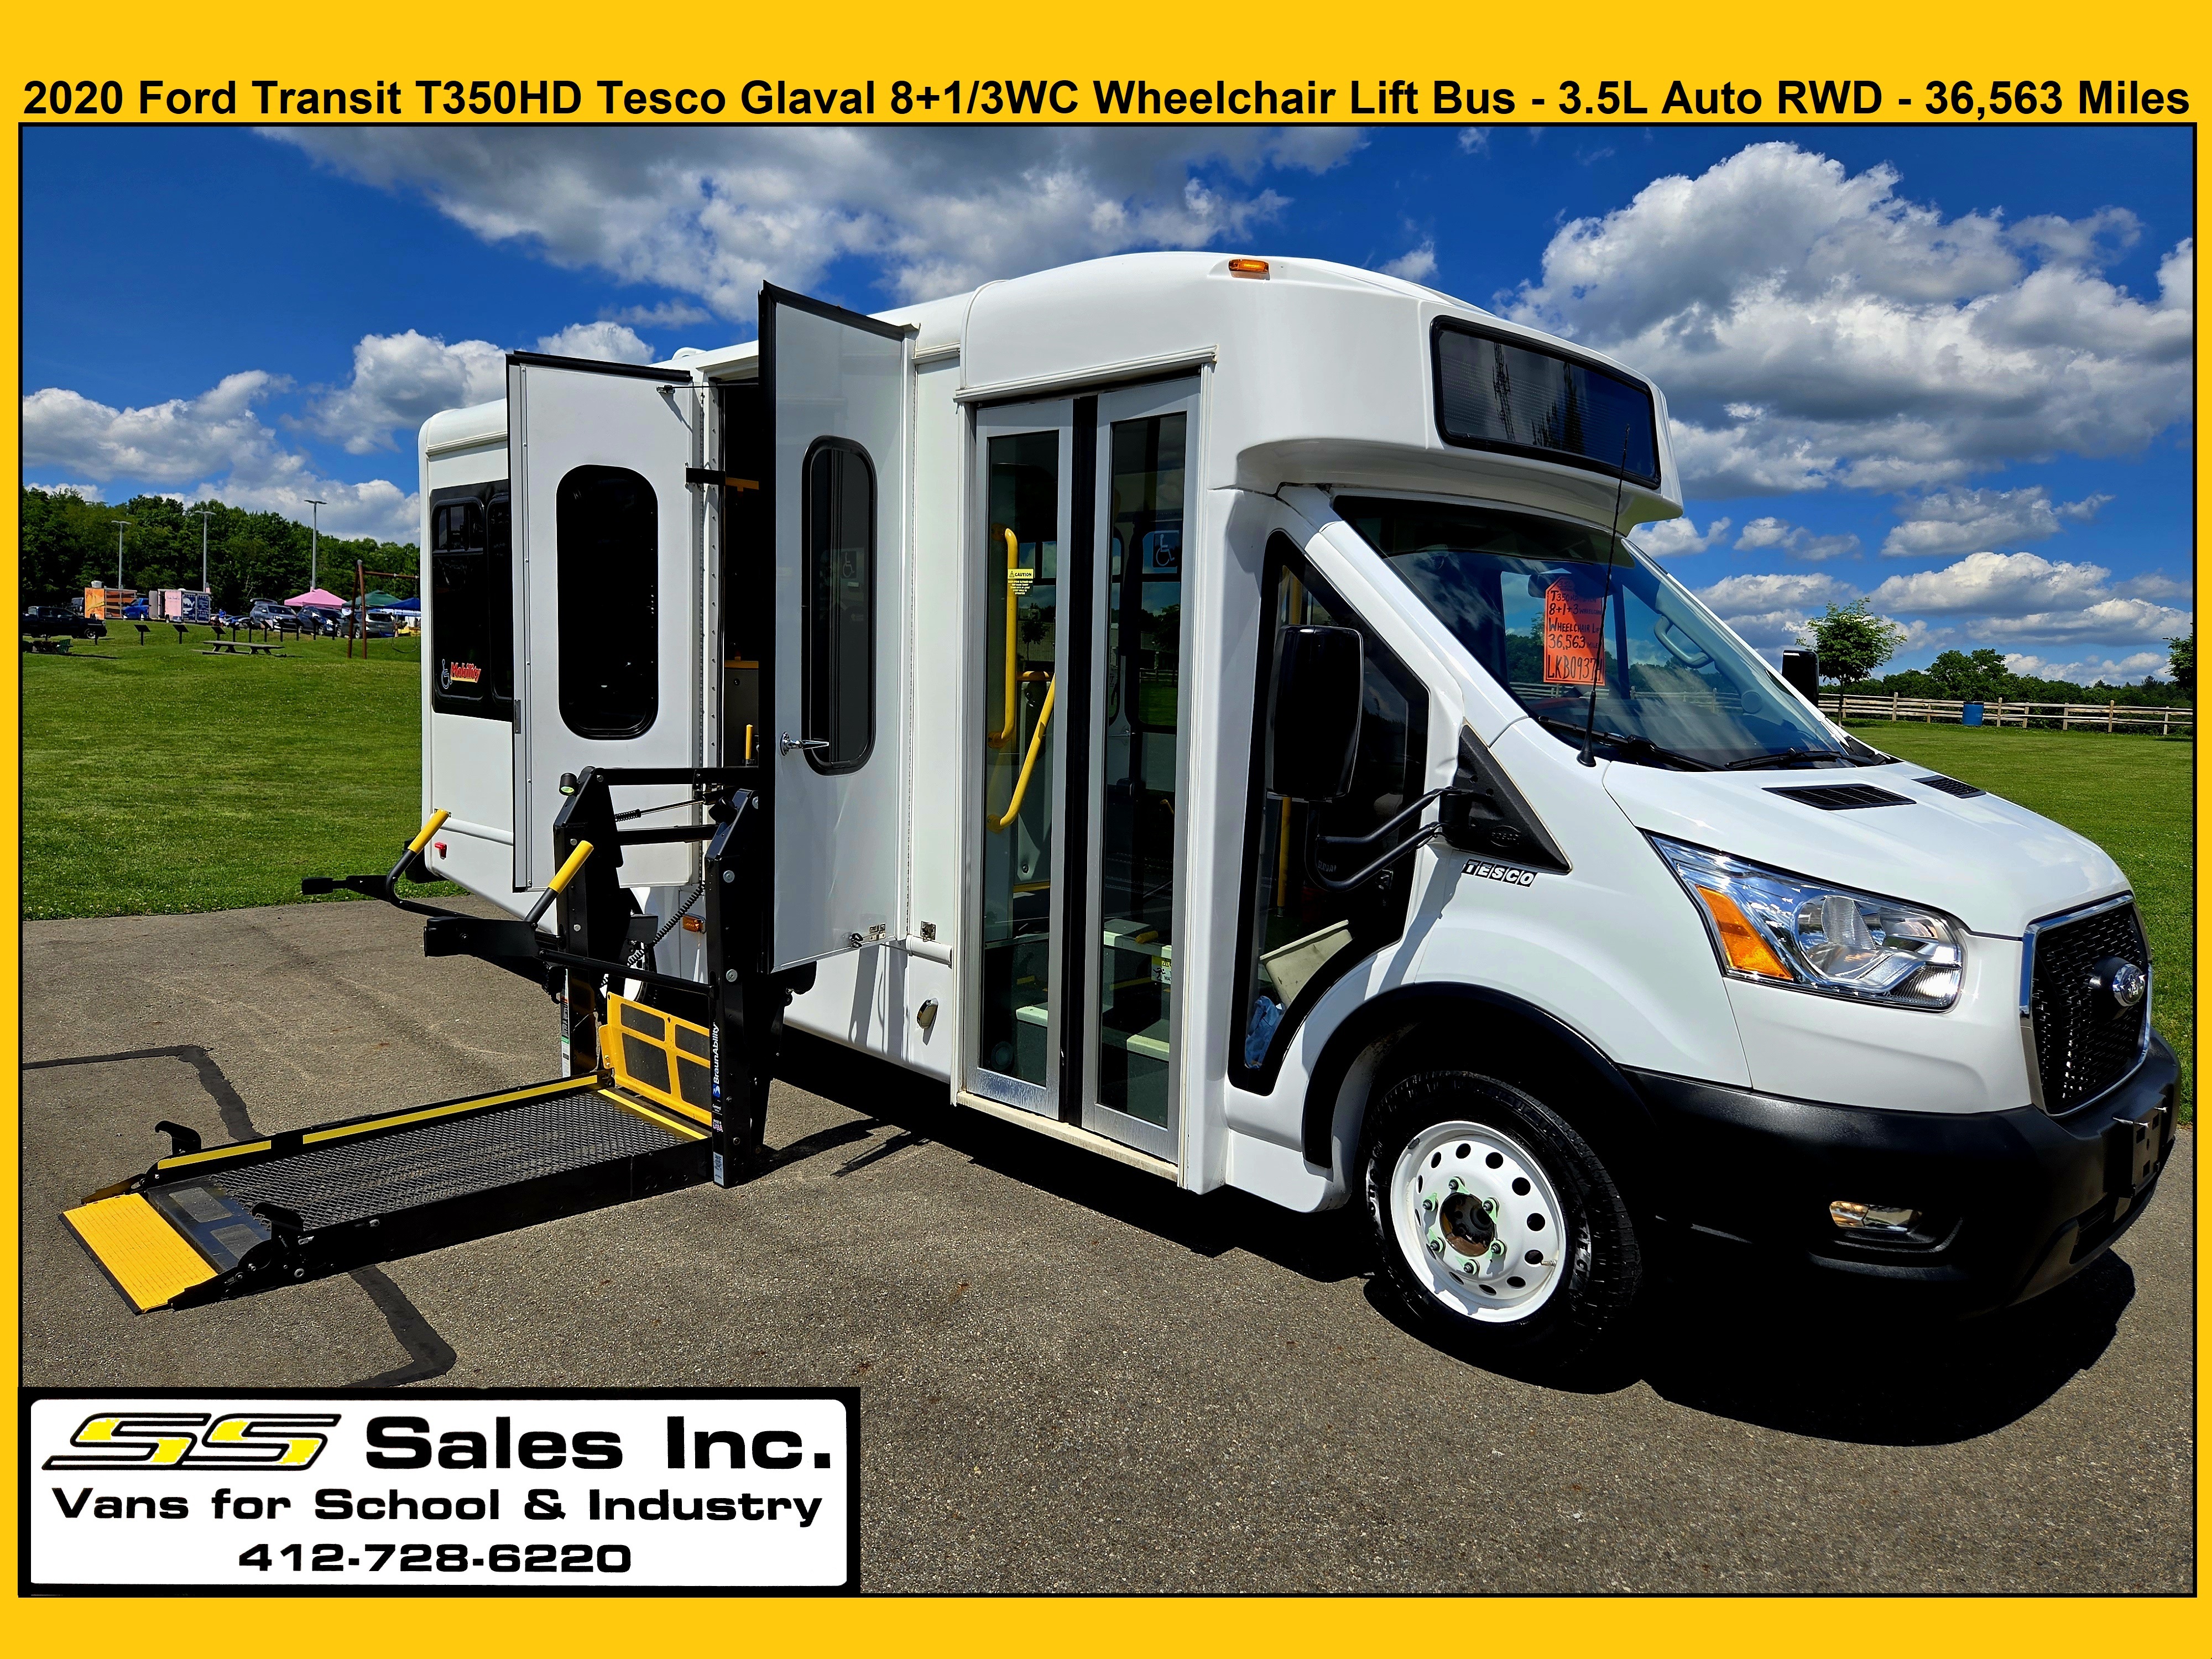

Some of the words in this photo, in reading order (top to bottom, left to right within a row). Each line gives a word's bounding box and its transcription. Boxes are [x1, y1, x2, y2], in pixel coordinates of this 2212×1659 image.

[1549, 603, 1579, 615] 8+1+3
[1548, 617, 1590, 633] WHEELCHAIR
[1548, 633, 1586, 650] 36,563
[450, 662, 482, 683] Mobility
[1466, 860, 1535, 885] TESCO
